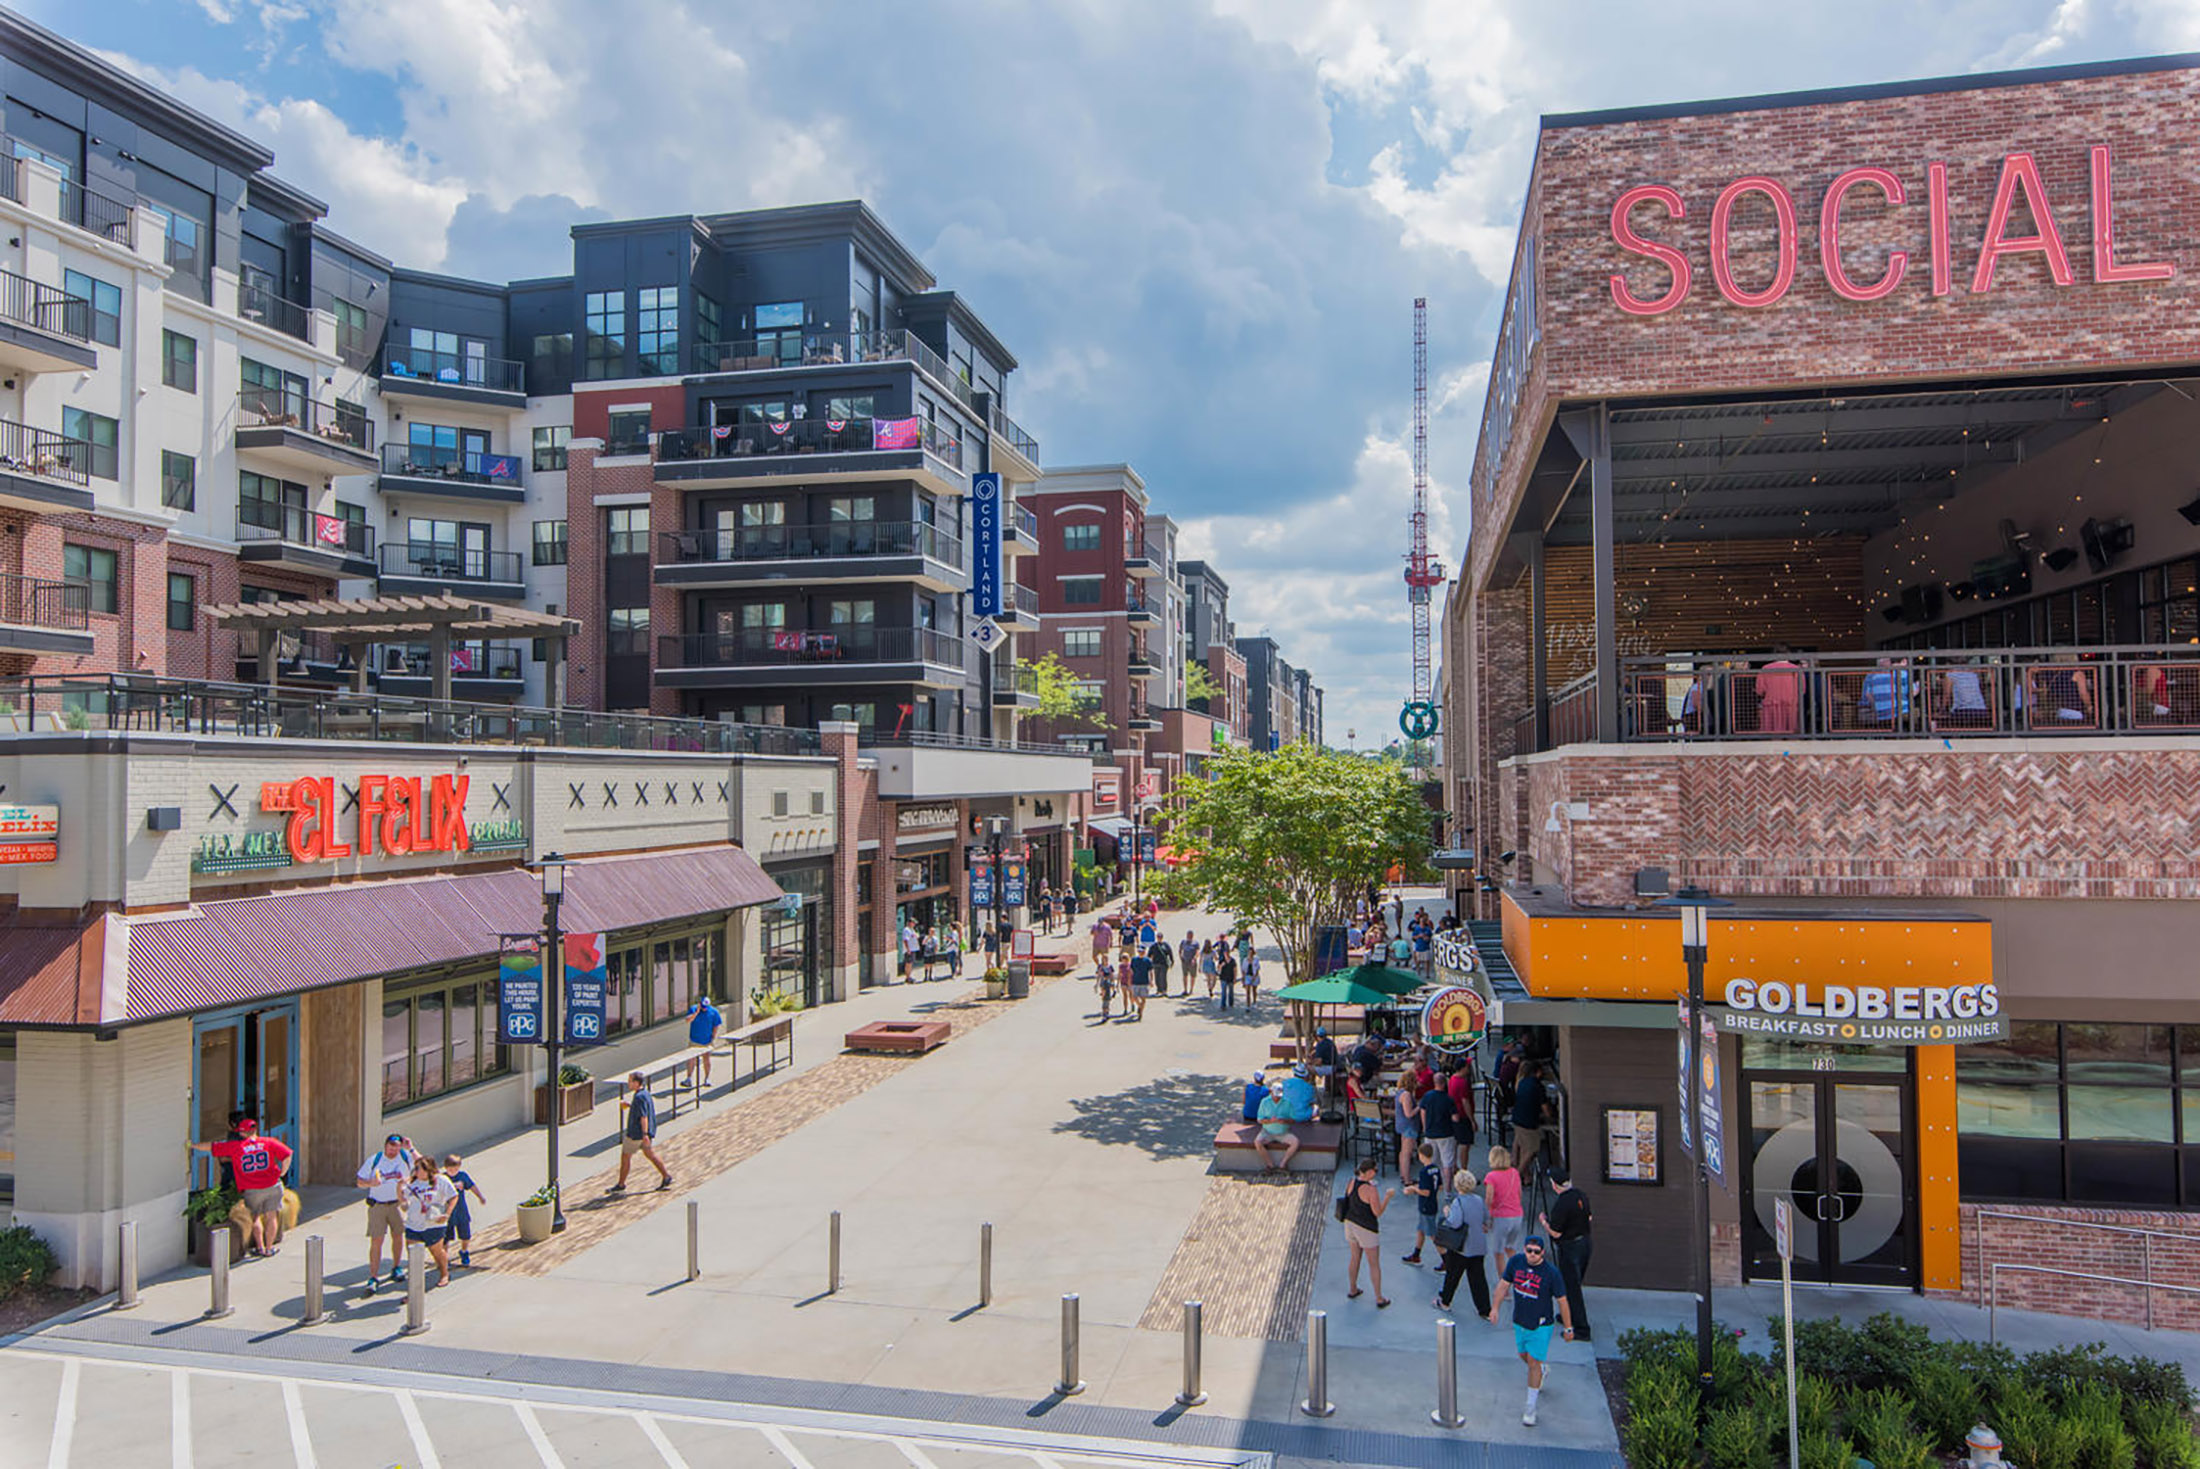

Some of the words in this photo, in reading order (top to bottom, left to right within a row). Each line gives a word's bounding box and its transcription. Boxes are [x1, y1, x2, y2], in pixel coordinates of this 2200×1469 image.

[1609, 144, 2175, 315] SOCIAL
[981, 503, 991, 608] CORTLAND
[981, 626, 992, 642] 3
[287, 776, 350, 863] EL
[359, 774, 470, 856] FELIX
[200, 832, 235, 858] TEX
[243, 831, 284, 857] MEX
[1725, 978, 1999, 1020] GOLDBERGS
[510, 1016, 535, 1034] PPG
[575, 1017, 597, 1034] PPG
[1725, 1014, 1838, 1036] BREAKFAST
[1860, 1025, 1926, 1039] LUNCH
[1946, 1022, 1999, 1038] DINNER
[1812, 1058, 1835, 1070] 730
[242, 1151, 269, 1173] 29
